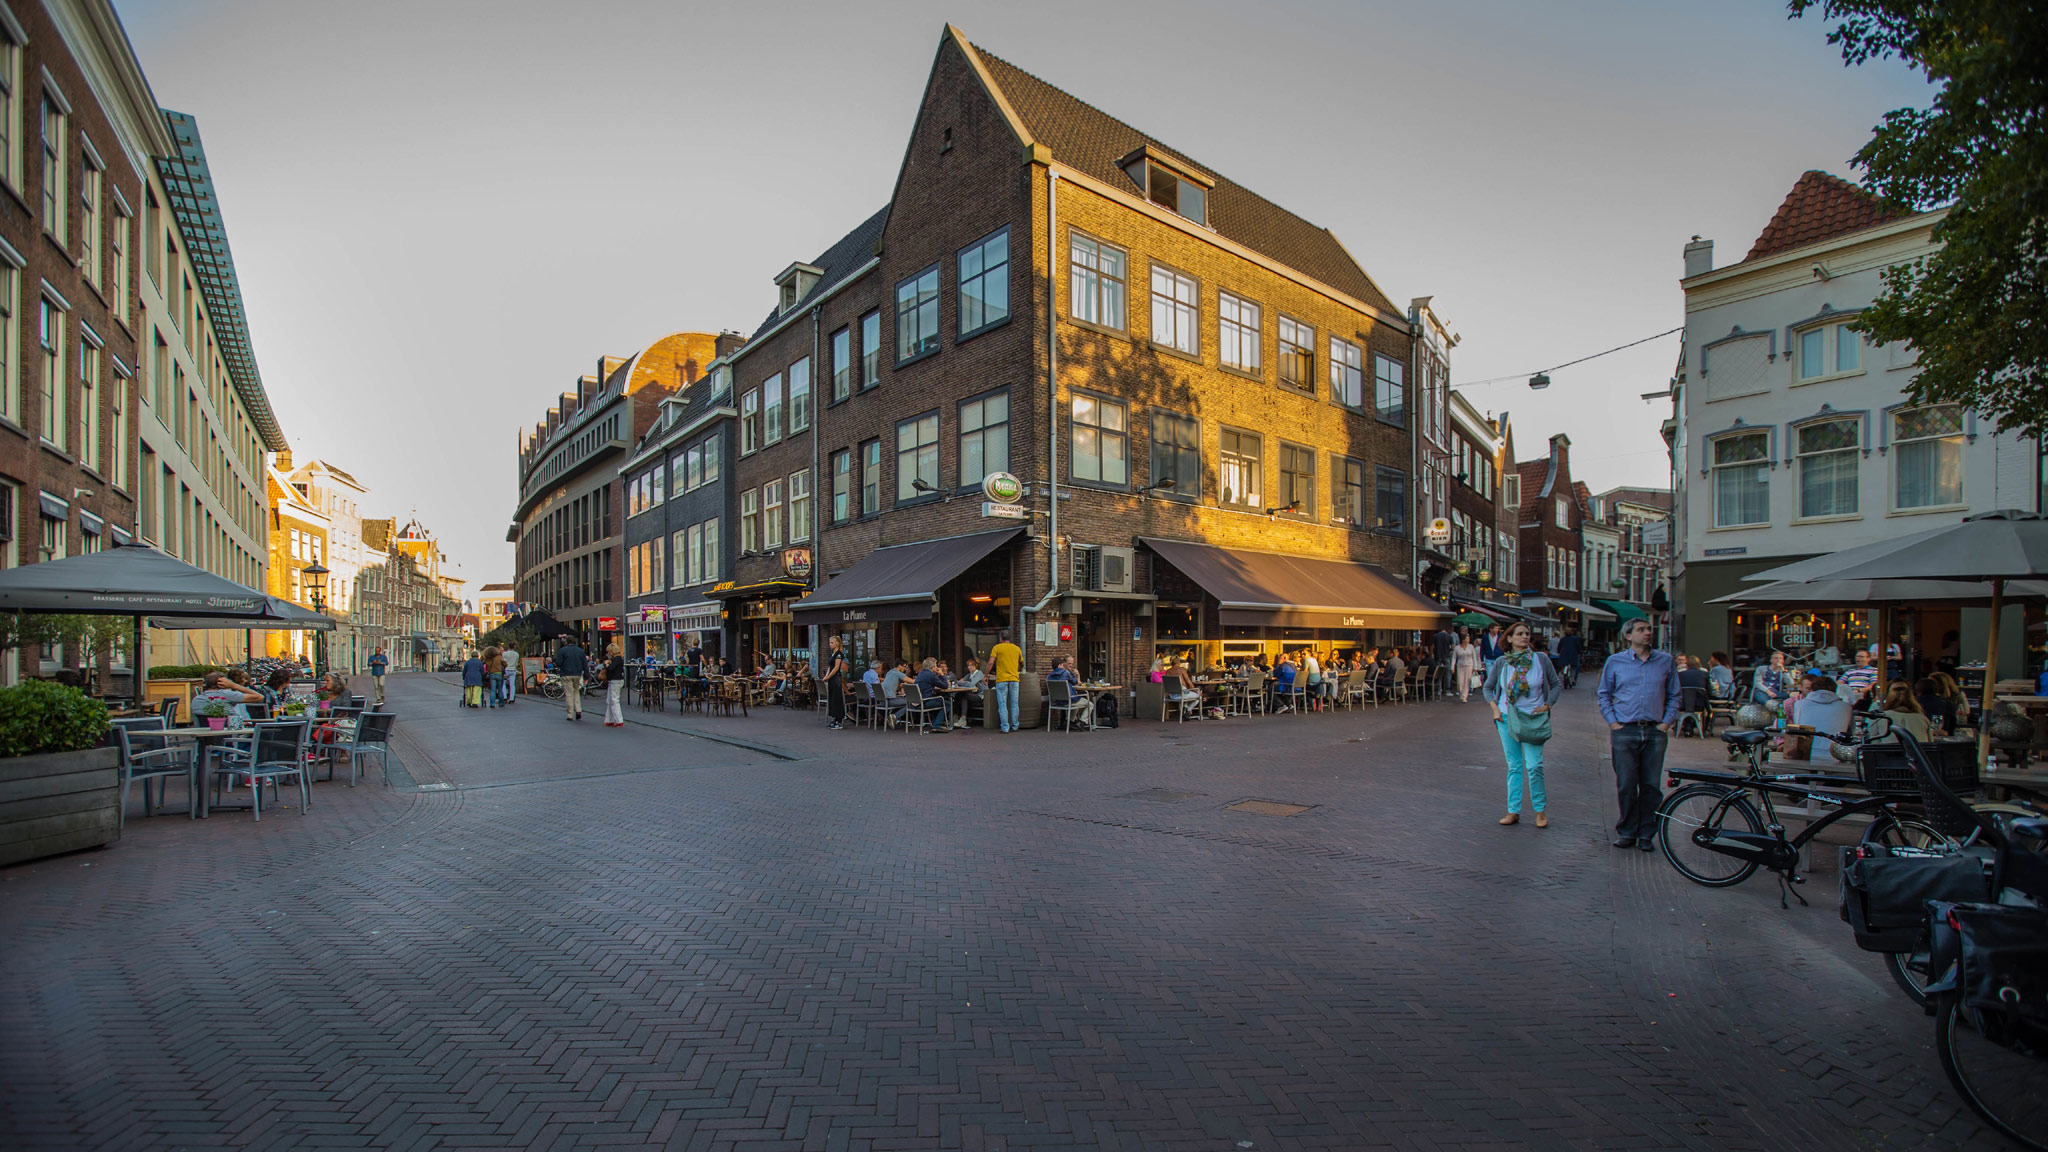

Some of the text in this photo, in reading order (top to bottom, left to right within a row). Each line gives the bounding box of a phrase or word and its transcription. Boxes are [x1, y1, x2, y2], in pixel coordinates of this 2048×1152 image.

[995, 480, 1018, 493] Brand
[990, 504, 1021, 513] RESTAURANT
[843, 609, 867, 620] La Plume
[1343, 615, 1364, 626] La Plume
[1061, 627, 1072, 639] illy
[1781, 624, 1815, 634] THRILL
[1782, 634, 1816, 644] GRILL
